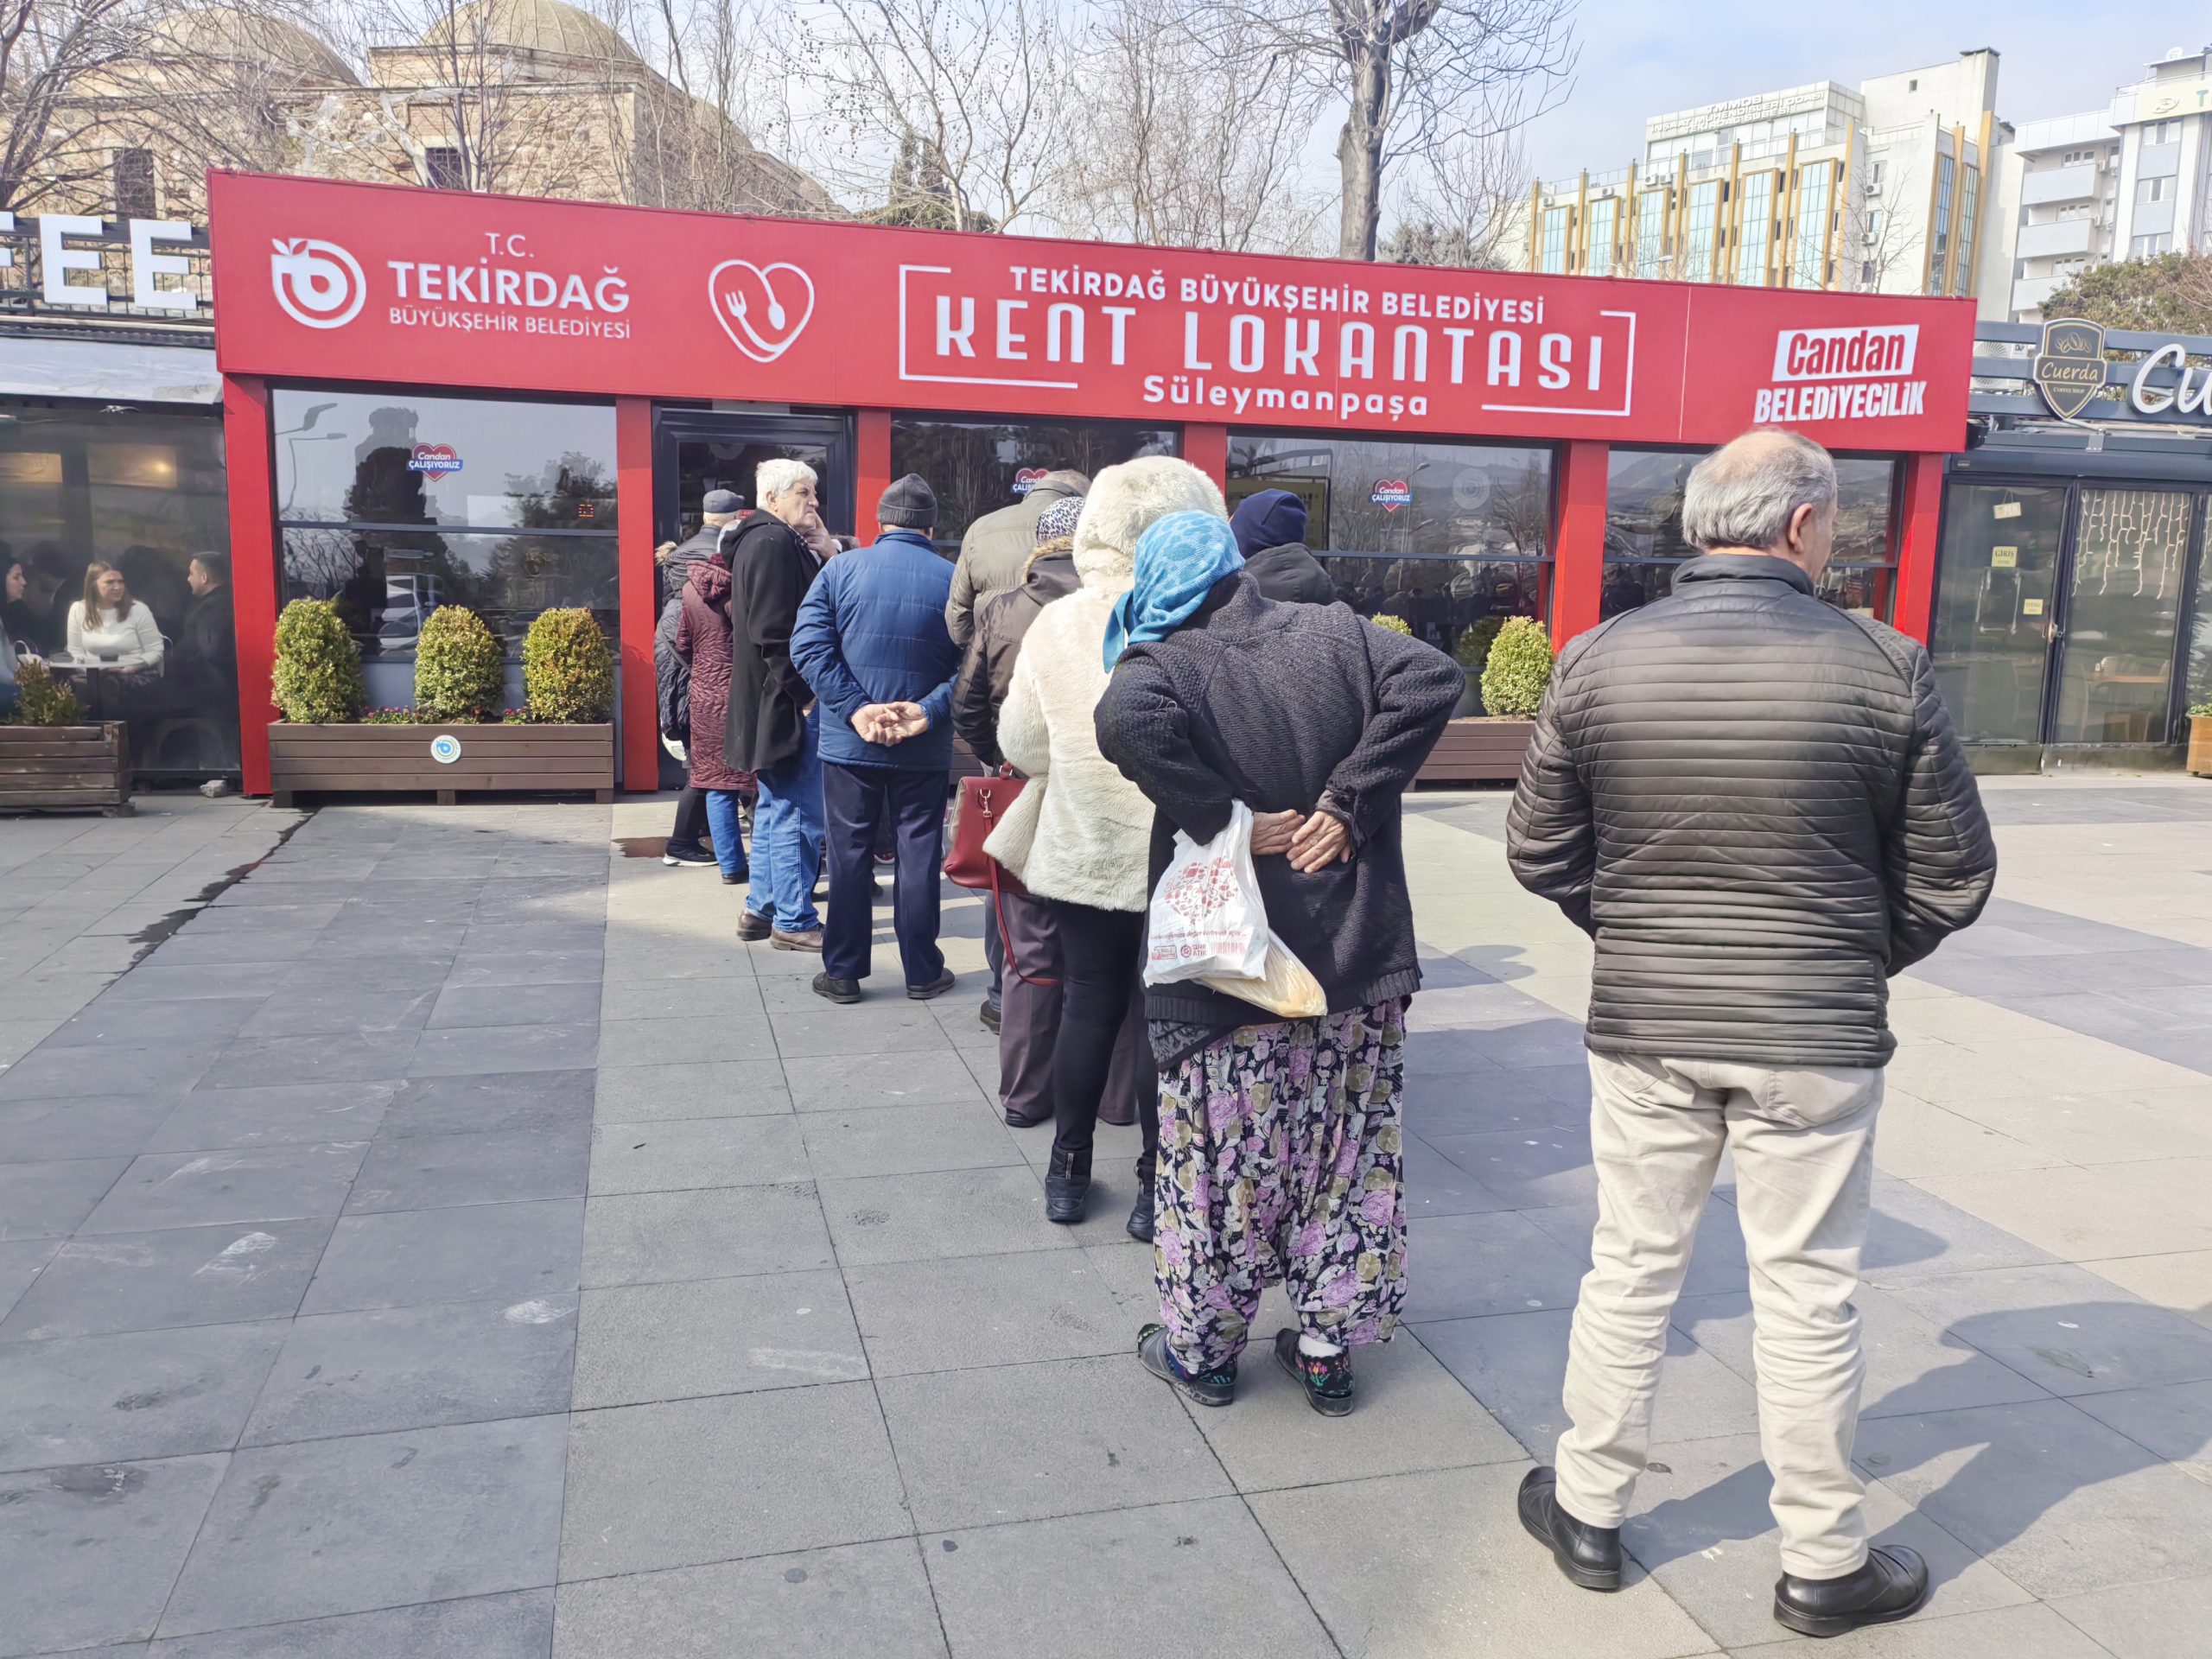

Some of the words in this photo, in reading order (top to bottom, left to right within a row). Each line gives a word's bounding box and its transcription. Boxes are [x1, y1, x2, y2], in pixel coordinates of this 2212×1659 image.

[485, 232, 534, 257] T.C.
[387, 257, 630, 313] TEKİRDAĞ
[1009, 264, 1166, 301] TEKİRDAĞ
[1180, 273, 1370, 313] BÜYÜKŞEHİR
[1382, 290, 1544, 325] BELEDİYESİ
[389, 304, 518, 333] BÜYÜKŞEHİR
[525, 316, 631, 340] BELEDİYESİ
[936, 295, 1136, 366] KENT
[1184, 311, 1603, 391] LOKANTASI
[1786, 329, 1906, 377] Candan
[2041, 361, 2098, 382] Cuerda
[1143, 374, 1428, 421] Süleymanpaşa
[1752, 380, 1928, 423] BELEDİYECİLİK
[409, 461, 461, 470] ÇALIŞIYORUZ
[417, 452, 451, 461] Candan
[1372, 494, 1411, 503] ÇALIŞIYORUZ
